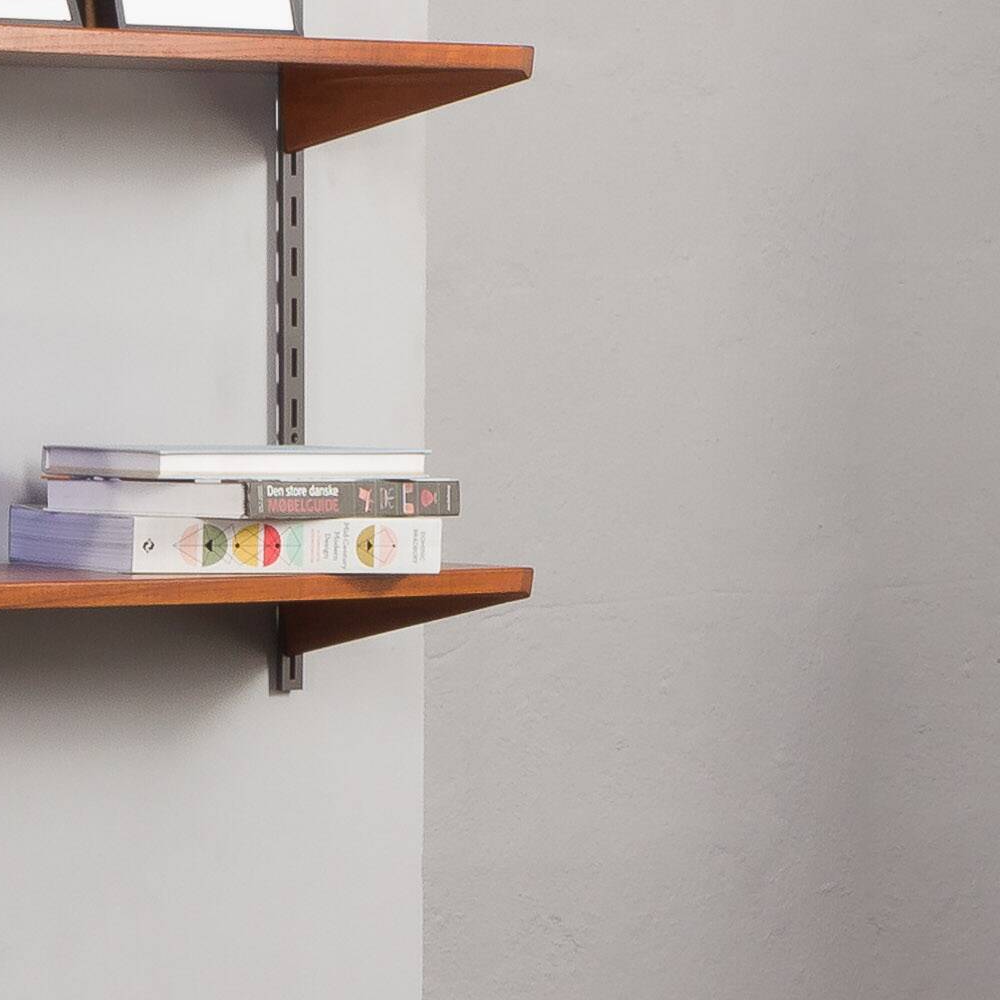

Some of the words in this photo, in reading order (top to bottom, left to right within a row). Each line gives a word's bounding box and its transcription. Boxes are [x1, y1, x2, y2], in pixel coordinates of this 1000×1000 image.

[266, 484, 284, 497] Den
[285, 485, 307, 497] store
[309, 484, 339, 497] danske
[267, 498, 339, 513] MØBELGUIDE
